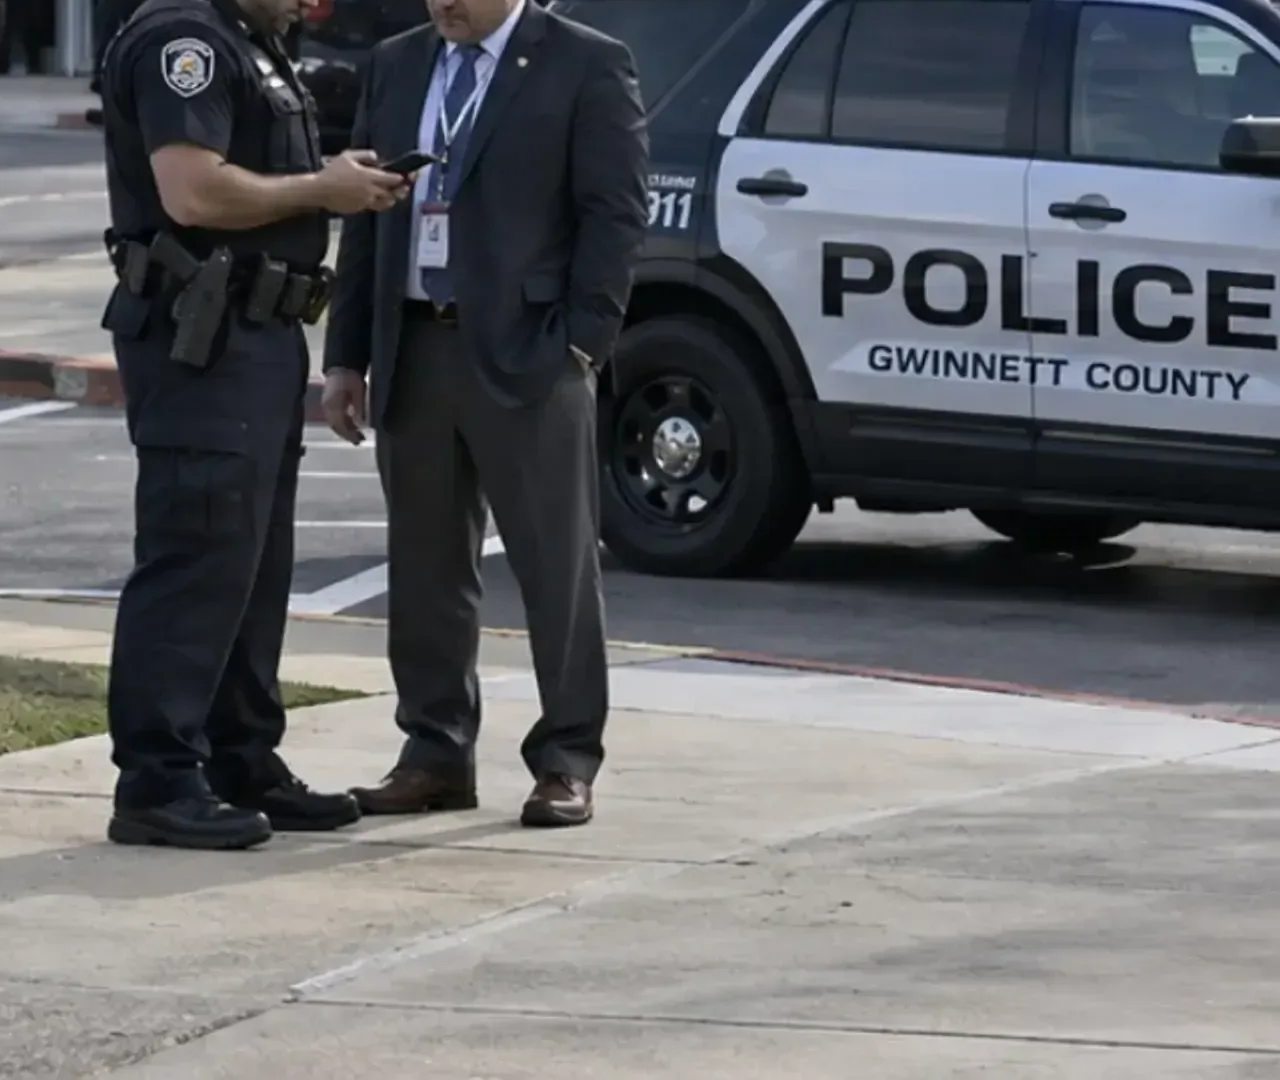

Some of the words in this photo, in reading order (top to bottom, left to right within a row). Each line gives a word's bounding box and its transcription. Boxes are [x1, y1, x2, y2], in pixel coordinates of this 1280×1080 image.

[647, 190, 692, 229] 911
[821, 241, 1278, 350] POLICE
[868, 344, 1070, 386] GWINNETT
[1085, 362, 1250, 401] COUNTY
